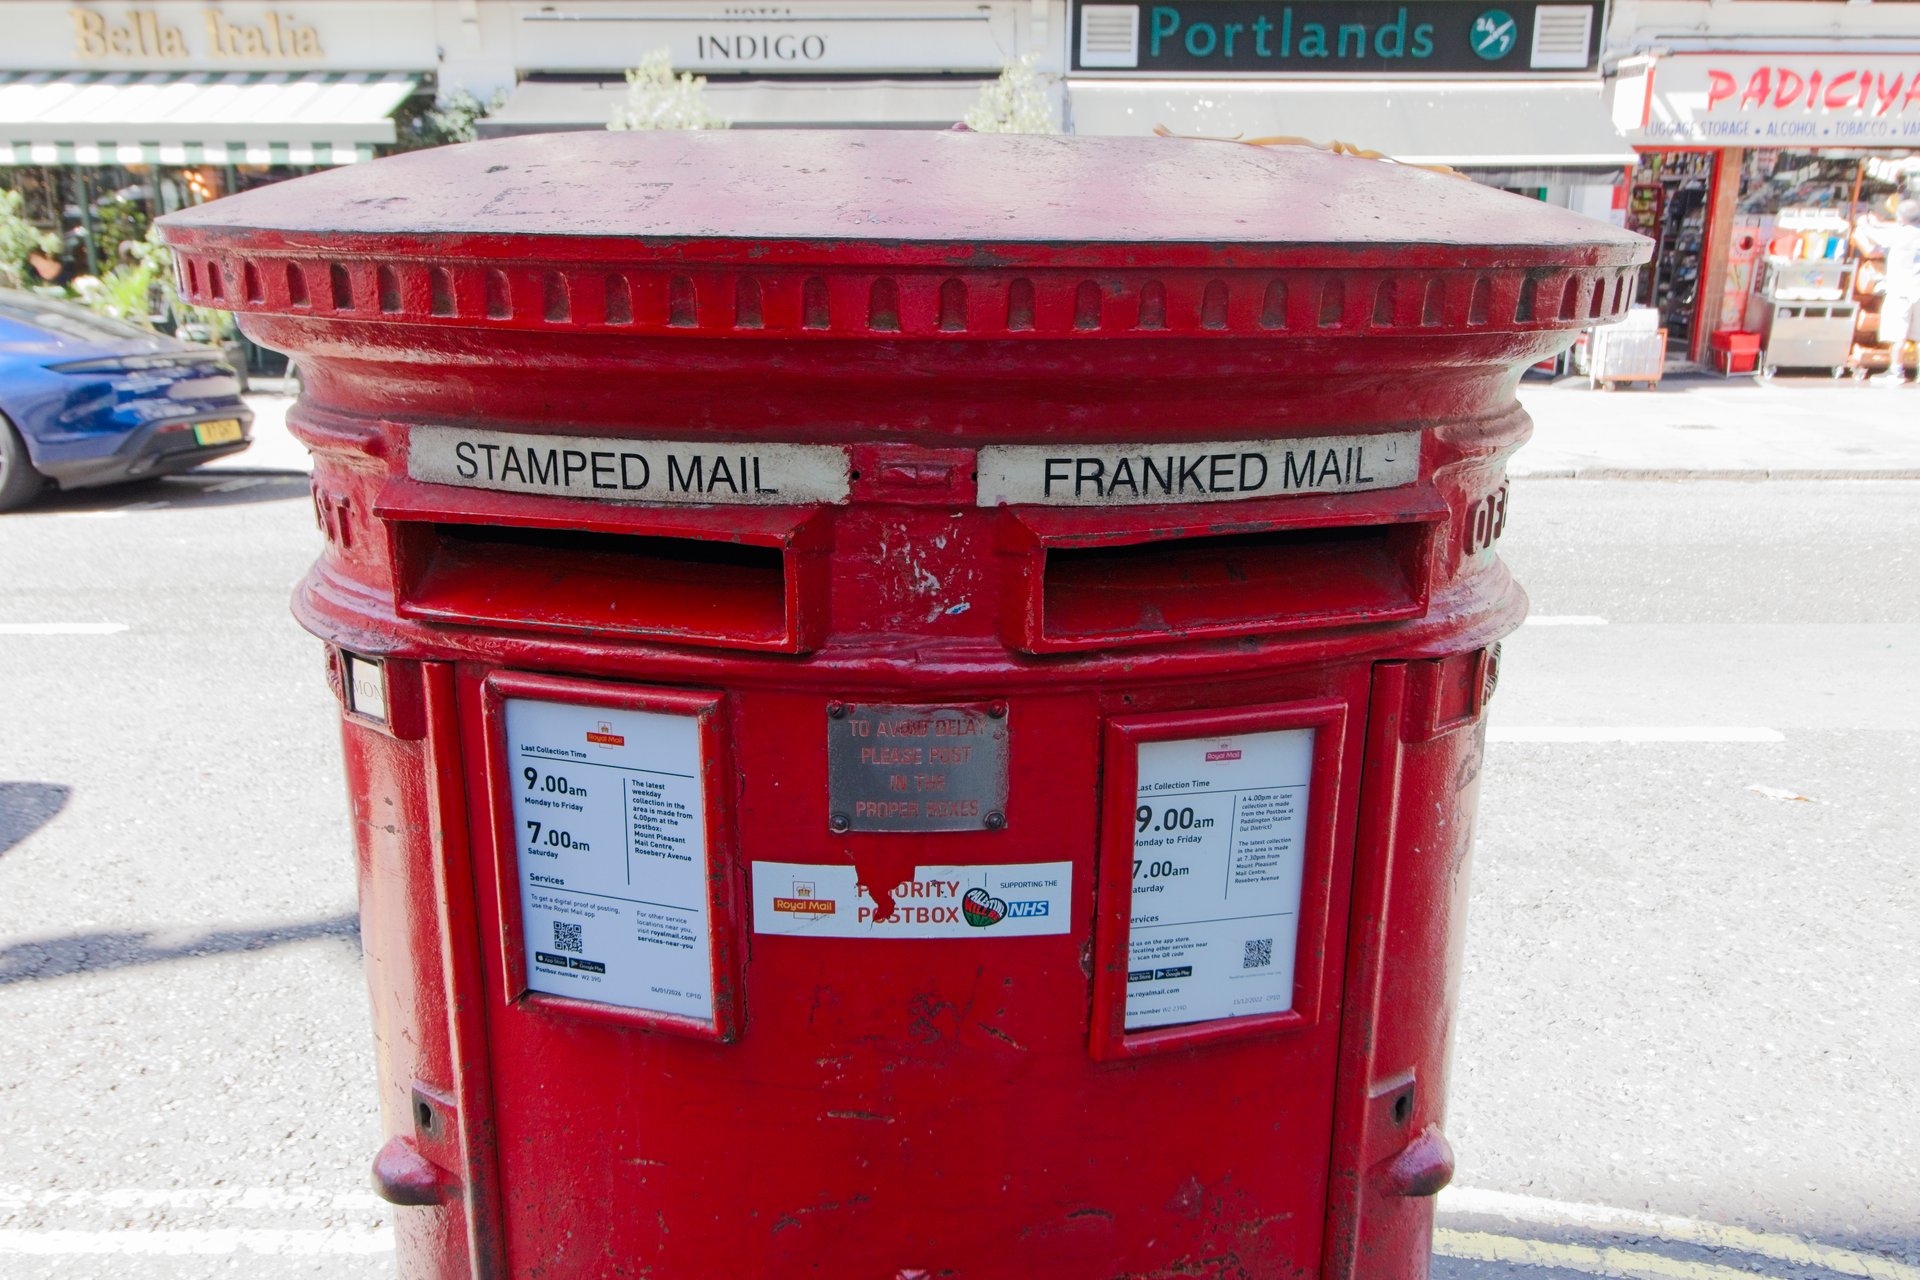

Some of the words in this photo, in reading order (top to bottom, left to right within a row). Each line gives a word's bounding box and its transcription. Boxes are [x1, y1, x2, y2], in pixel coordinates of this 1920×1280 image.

[67, 8, 190, 60] Bella
[1150, 7, 1434, 58] Portlands
[698, 35, 825, 60] INDIGO
[1701, 120, 1750, 137] STORAGE
[1766, 120, 1818, 137] ALCOHOL
[1835, 120, 1888, 137] TOBACCO
[456, 441, 650, 490] STAMPED
[667, 454, 779, 495] MAIL
[1044, 452, 1268, 498] FRANKED
[1283, 446, 1374, 489] MAIL
[849, 720, 870, 737] TO
[876, 720, 928, 738] AVOID
[936, 720, 986, 737] DELAY
[521, 744, 535, 752] Last
[536, 746, 570, 756] Collection
[570, 750, 587, 758] Time
[862, 746, 922, 764] PLEASE
[930, 746, 972, 764] POST
[1207, 752, 1225, 760] Royal
[524, 767, 587, 797] 9.00am
[646, 782, 665, 790] latest
[890, 775, 908, 791] IN
[914, 775, 946, 791] THE
[1154, 781, 1190, 791] Collection
[1192, 780, 1210, 788] Time
[632, 790, 662, 798] weekday
[525, 797, 551, 808] Monday
[562, 802, 584, 812] Friday
[632, 798, 664, 807] collection
[856, 800, 920, 818] PROPER
[926, 801, 979, 818] BOXES
[633, 814, 658, 822] 4.00pm
[1136, 805, 1214, 833] 9.00am
[634, 823, 662, 832] postbox:
[527, 820, 590, 851] 7.00am
[634, 831, 655, 839] Mount
[656, 834, 686, 844] Pleasant
[1177, 835, 1202, 844] Friday
[634, 838, 649, 846] Mail
[650, 841, 674, 851] Centre,
[528, 848, 558, 859] Saturday
[635, 847, 666, 858] Rosebery
[667, 852, 692, 862] Avenue
[530, 873, 564, 885] Services
[1000, 880, 1042, 889] SUPPORTING
[1132, 884, 1164, 894] aturday
[554, 897, 572, 906] digital
[777, 900, 808, 912] Royal
[809, 900, 832, 911] Mail
[554, 906, 570, 914] Royal
[1008, 902, 1047, 916] NHS
[637, 920, 664, 928] locations
[666, 916, 687, 924] service
[1130, 915, 1159, 924] ervices
[651, 930, 696, 942] royalmail.com/
[638, 936, 693, 949] services-near-you
[536, 966, 556, 974] Postbox
[558, 970, 578, 978] number
